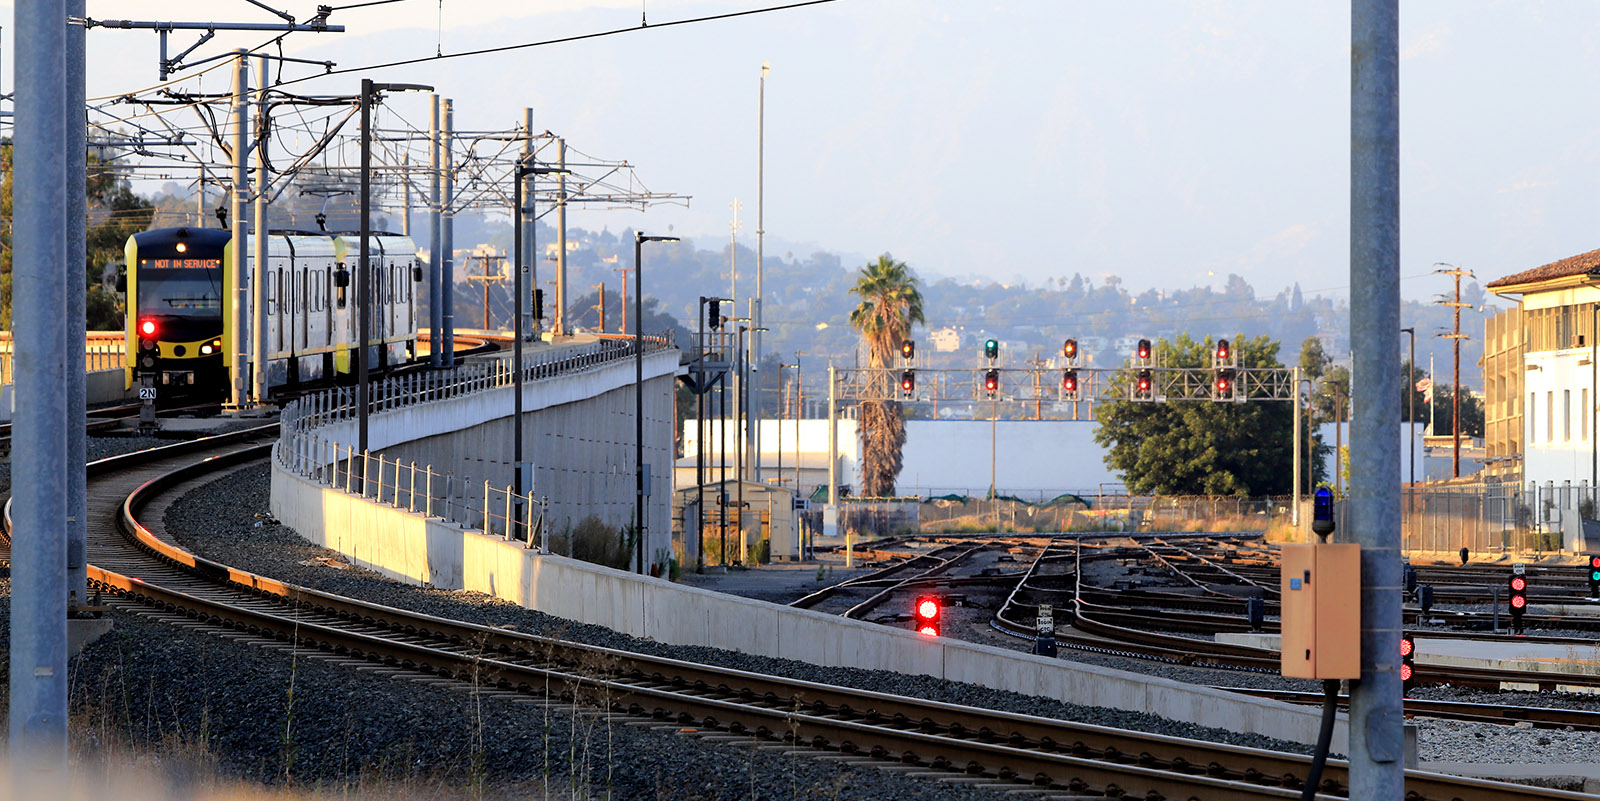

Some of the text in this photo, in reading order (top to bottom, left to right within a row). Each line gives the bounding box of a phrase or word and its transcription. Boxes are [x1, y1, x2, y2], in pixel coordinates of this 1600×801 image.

[154, 259, 216, 268] NOT IN SERVICE
[140, 388, 155, 398] 2N
